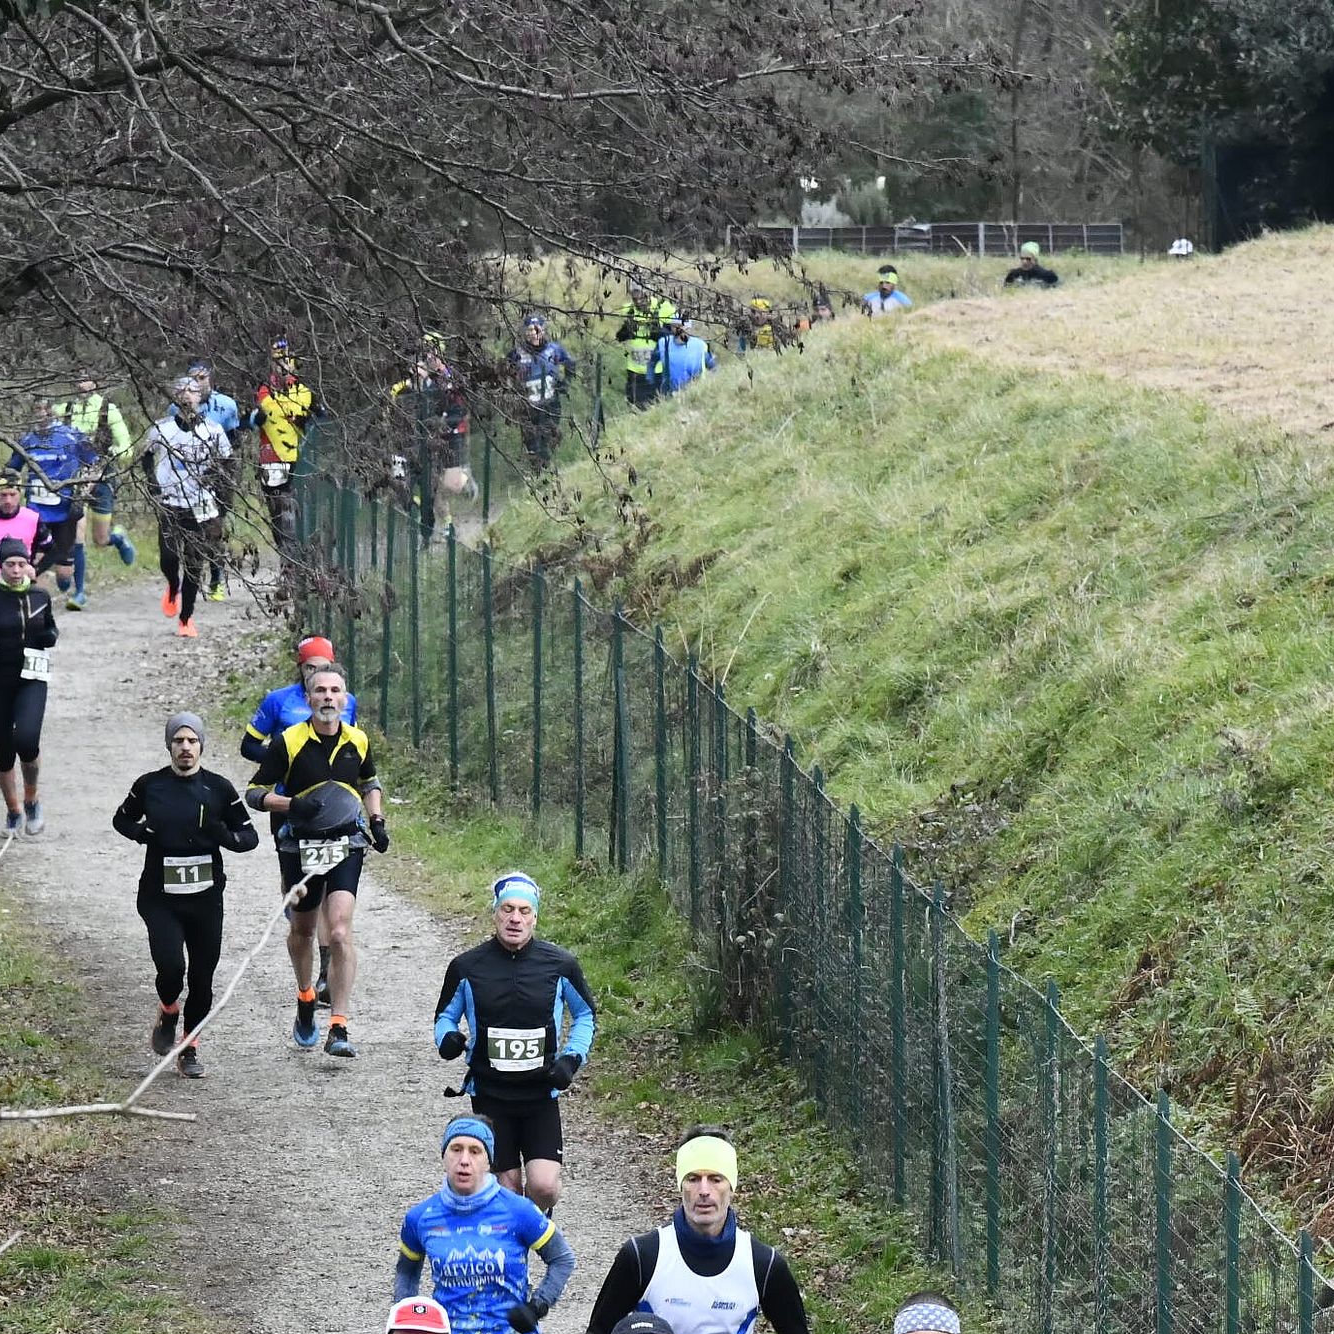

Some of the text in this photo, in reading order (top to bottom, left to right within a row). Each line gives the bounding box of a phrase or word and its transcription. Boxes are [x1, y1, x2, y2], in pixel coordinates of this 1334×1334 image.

[306, 846, 345, 865] 215
[176, 866, 199, 882] 11
[495, 1040, 539, 1059] 195
